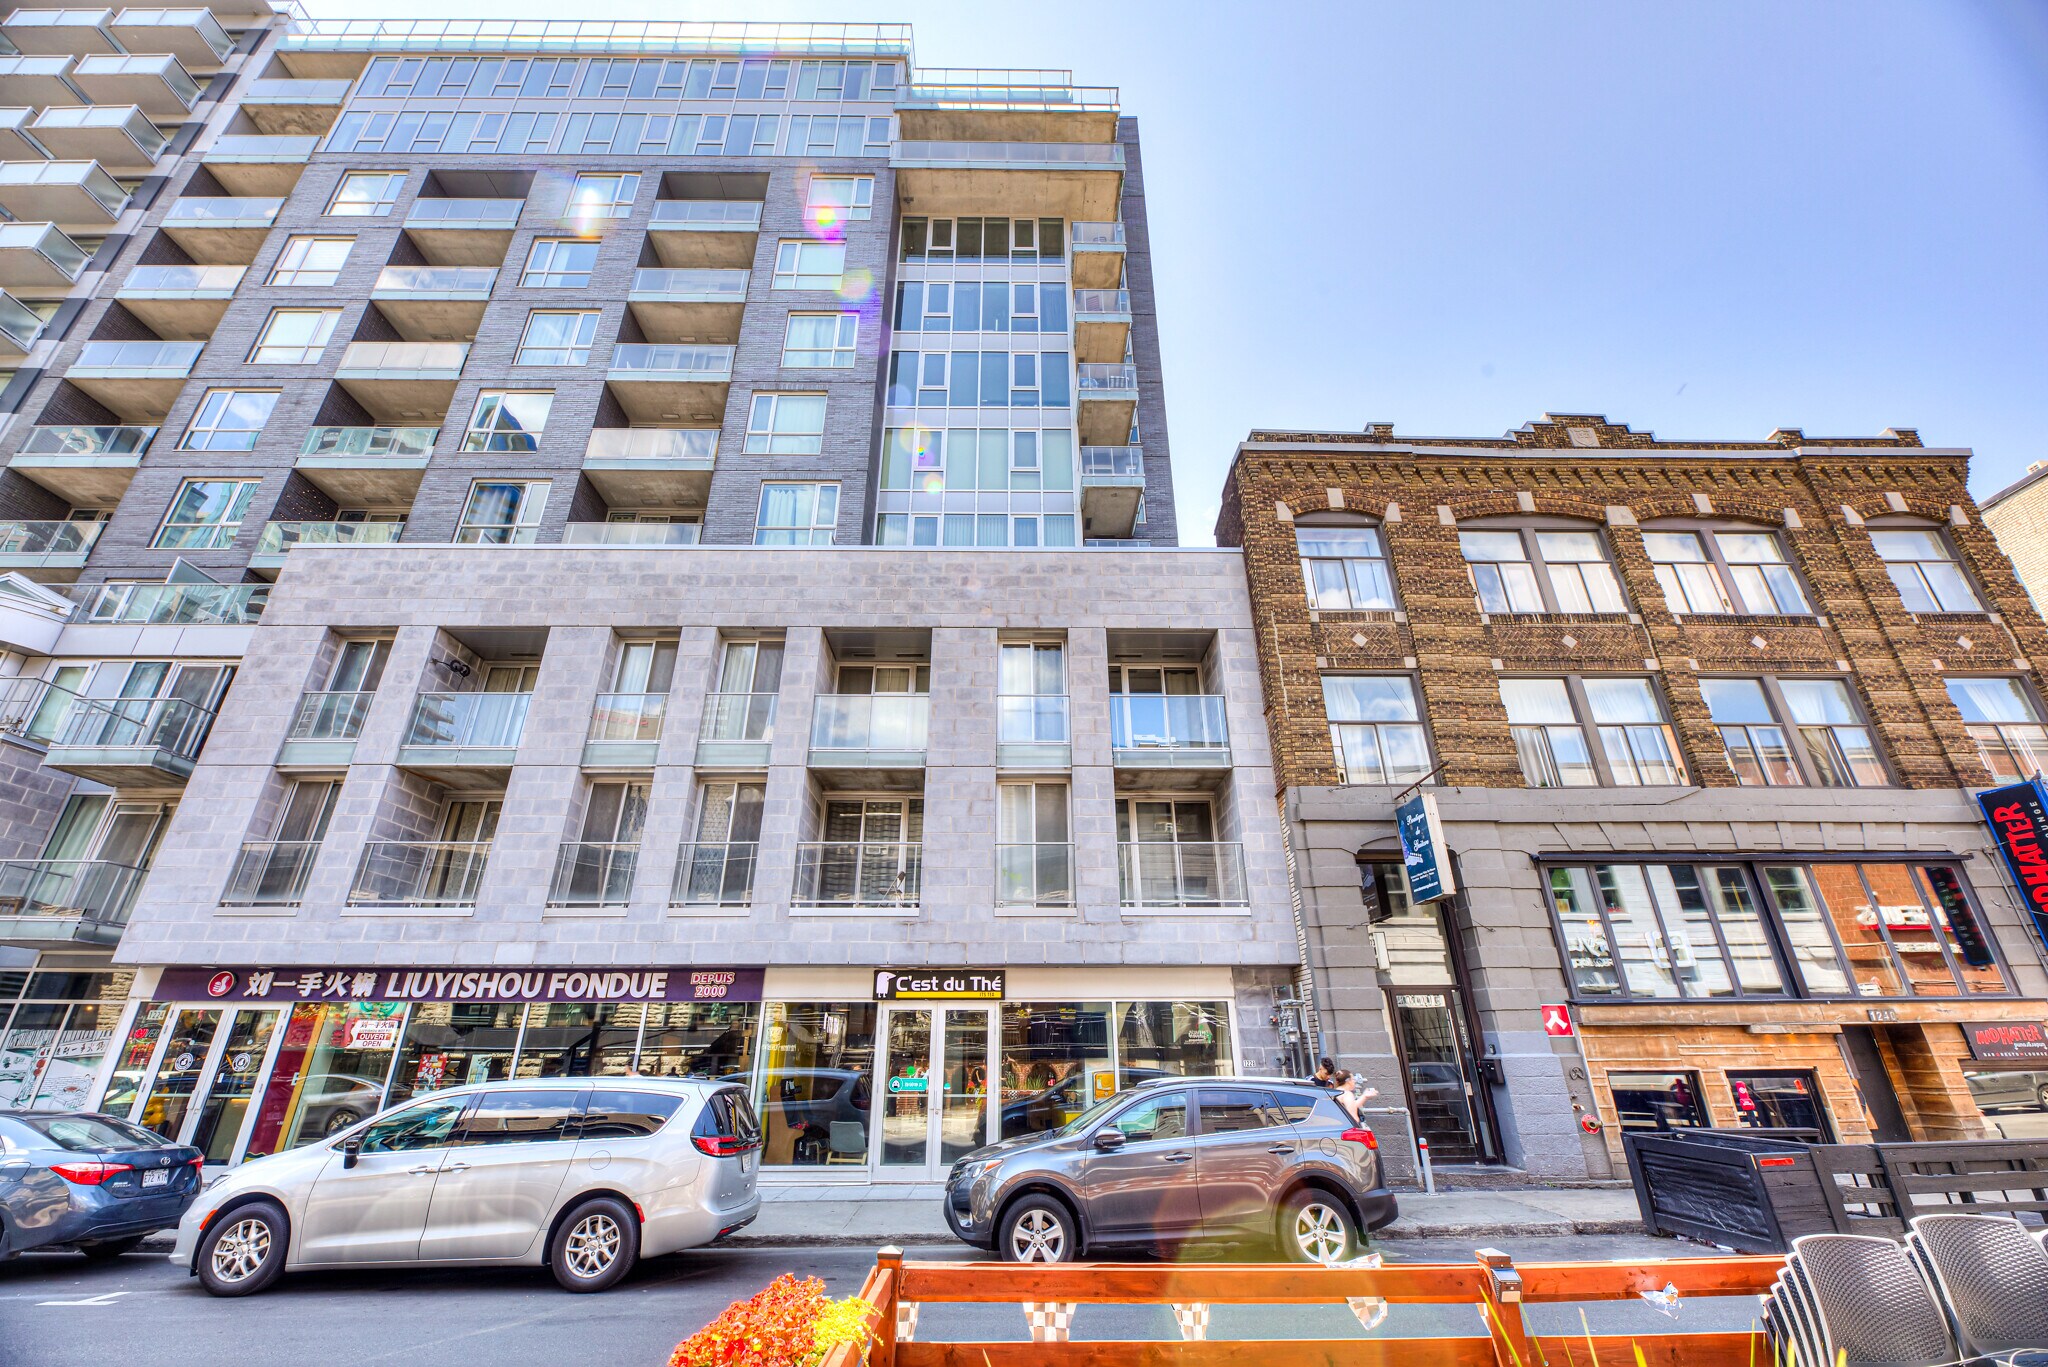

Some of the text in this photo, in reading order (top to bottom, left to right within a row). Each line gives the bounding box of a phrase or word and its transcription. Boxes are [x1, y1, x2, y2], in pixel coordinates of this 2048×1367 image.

[243, 971, 669, 998] 刘一手火锅 LIUYISHOU FONDUE
[690, 972, 735, 985] DEPUIS
[896, 974, 1002, 991] C'est du Thé
[694, 985, 728, 998] 2000
[149, 1011, 164, 1019] 1224
[1868, 1010, 1897, 1022] 1240
